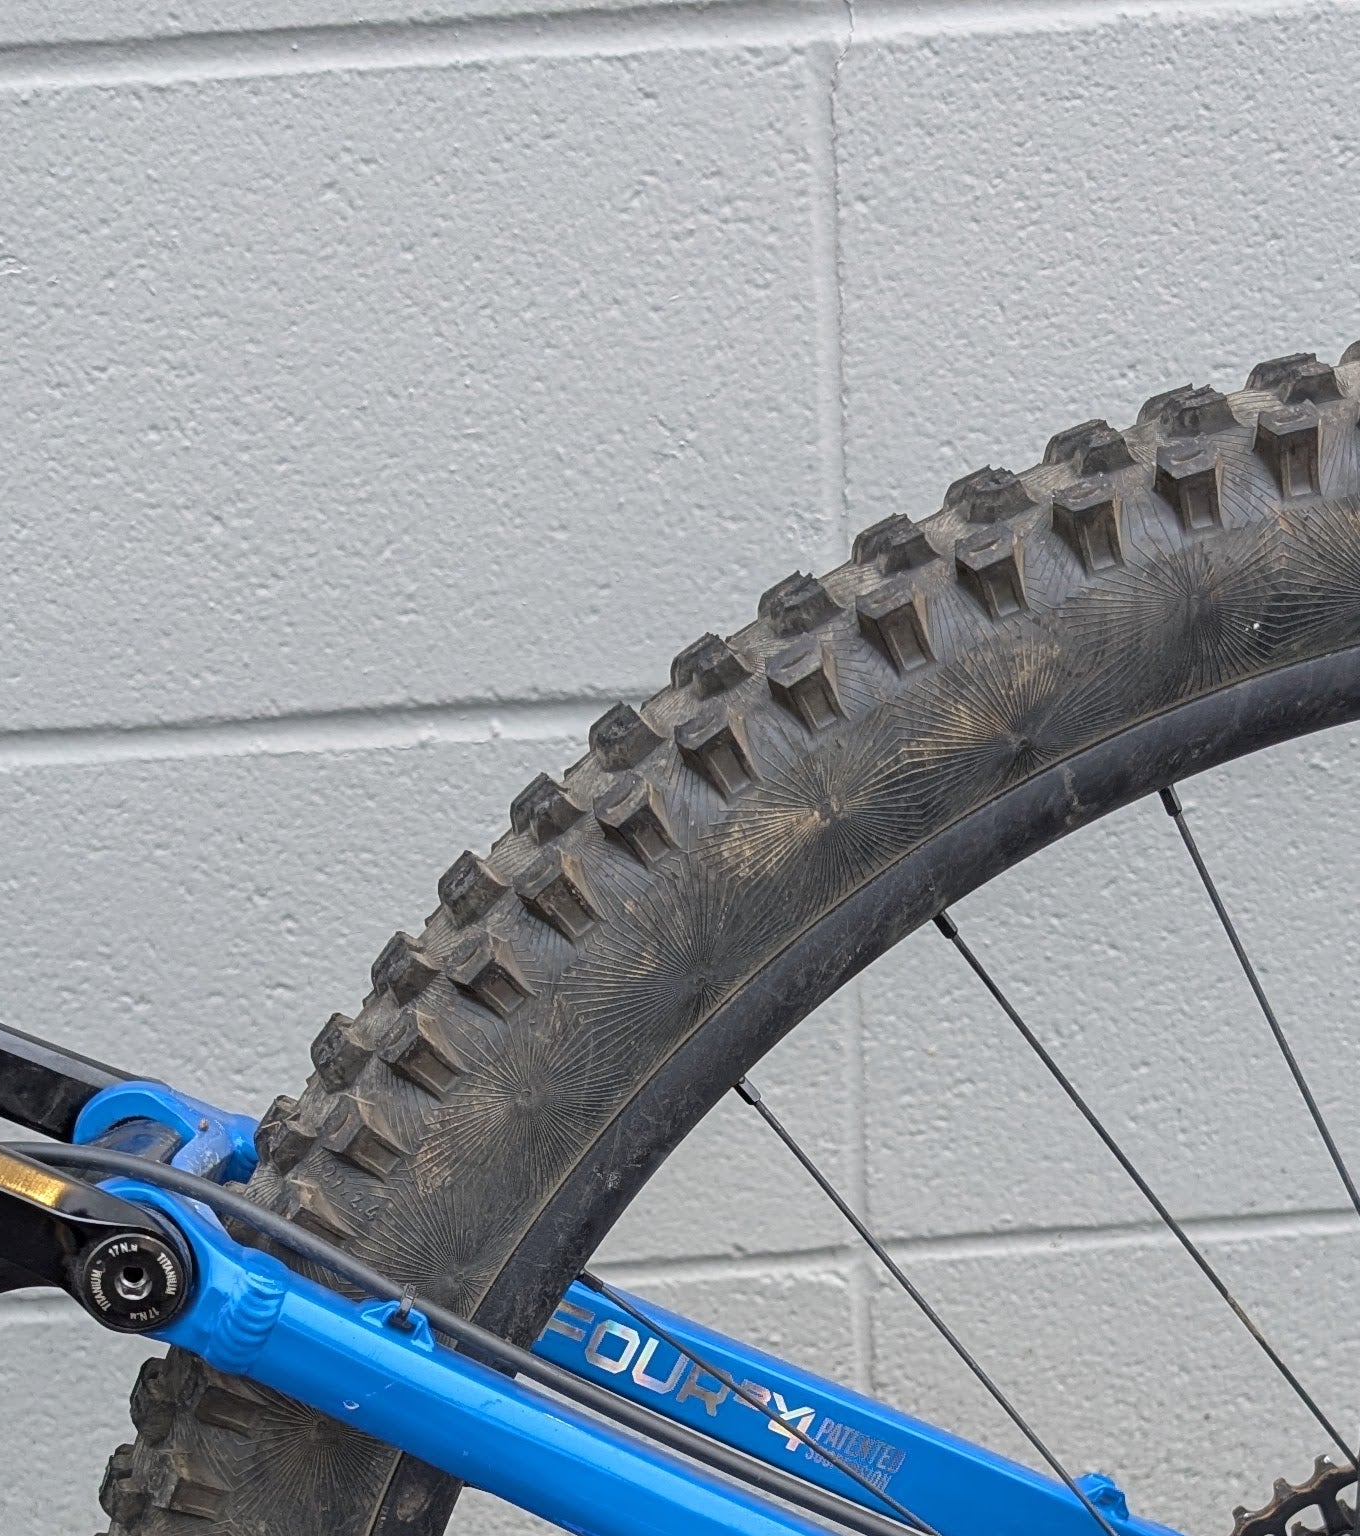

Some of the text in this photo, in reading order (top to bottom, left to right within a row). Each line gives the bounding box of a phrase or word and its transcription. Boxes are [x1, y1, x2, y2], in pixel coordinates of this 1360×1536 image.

[90, 1268, 112, 1312] TITANIUM
[157, 1252, 178, 1296] TITANIUM
[814, 1417, 907, 1474] PATENTED
